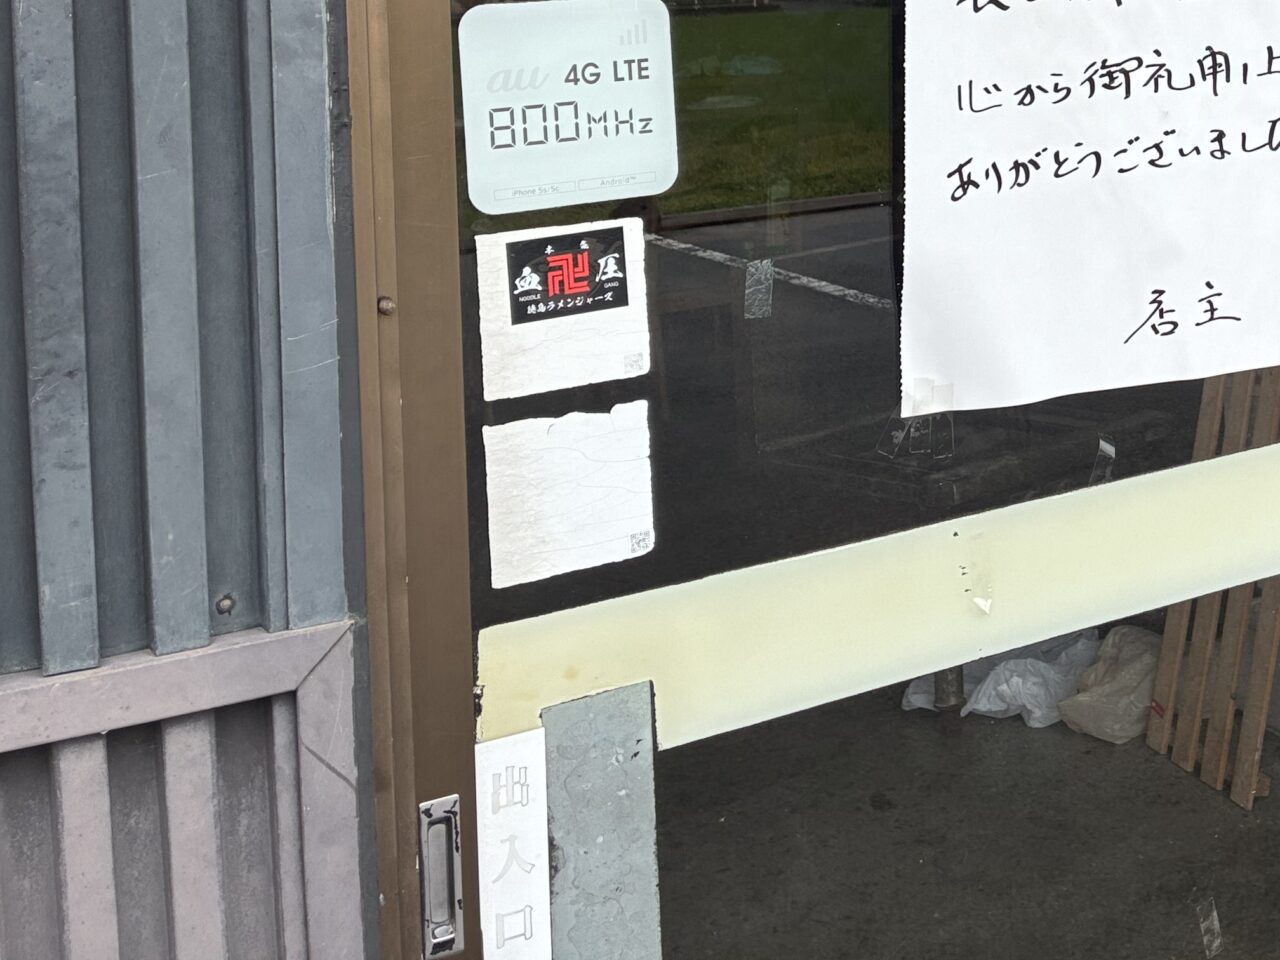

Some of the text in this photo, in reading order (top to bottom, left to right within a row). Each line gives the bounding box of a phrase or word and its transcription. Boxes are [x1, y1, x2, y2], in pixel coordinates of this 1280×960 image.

[487, 58, 650, 93] au 4G LTE
[1124, 281, 1241, 343] 店主
[491, 765, 535, 950] 出入口
